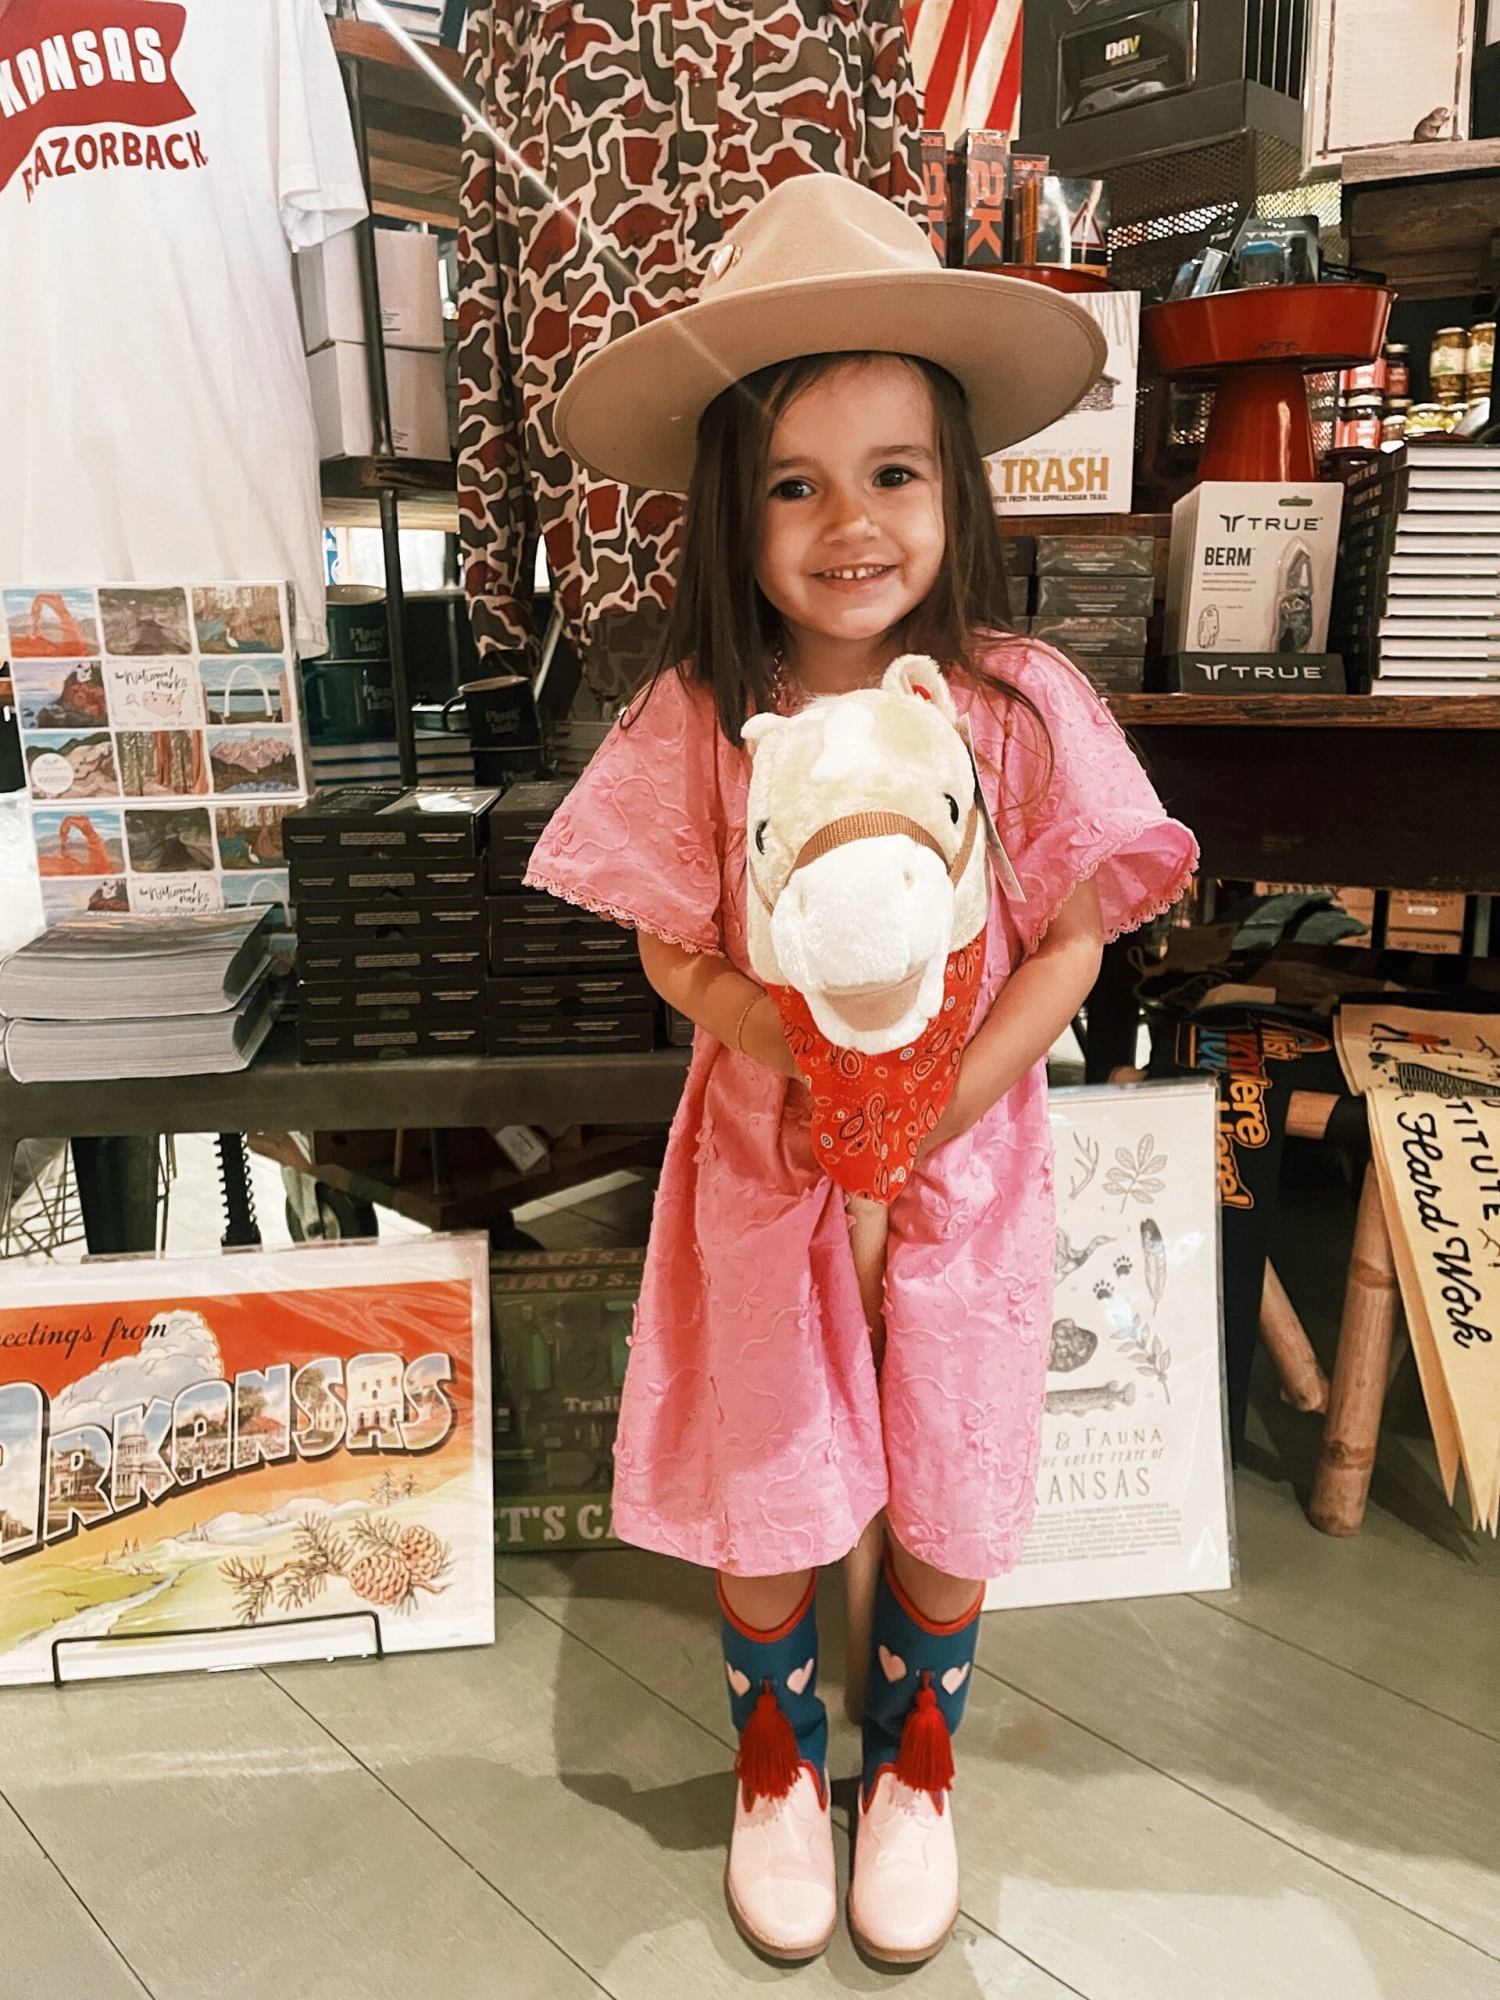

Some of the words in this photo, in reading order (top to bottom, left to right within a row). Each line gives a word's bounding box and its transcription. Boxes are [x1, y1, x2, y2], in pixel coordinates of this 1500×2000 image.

[1002, 457, 1109, 493] TRASH
[1090, 493, 1108, 501] TRAIL
[1247, 517, 1319, 531] TRUE
[1204, 547, 1252, 566] BERM
[1230, 665, 1322, 679] TRUE
[1229, 1074, 1270, 1147] ere
[1397, 1111, 1459, 1233] Hard
[1433, 1237, 1492, 1349] Work
[0, 1322, 96, 1359] eetings
[101, 1317, 168, 1357] from
[1035, 1467, 1150, 1505] ANSAS
[496, 1505, 566, 1542] T'S
